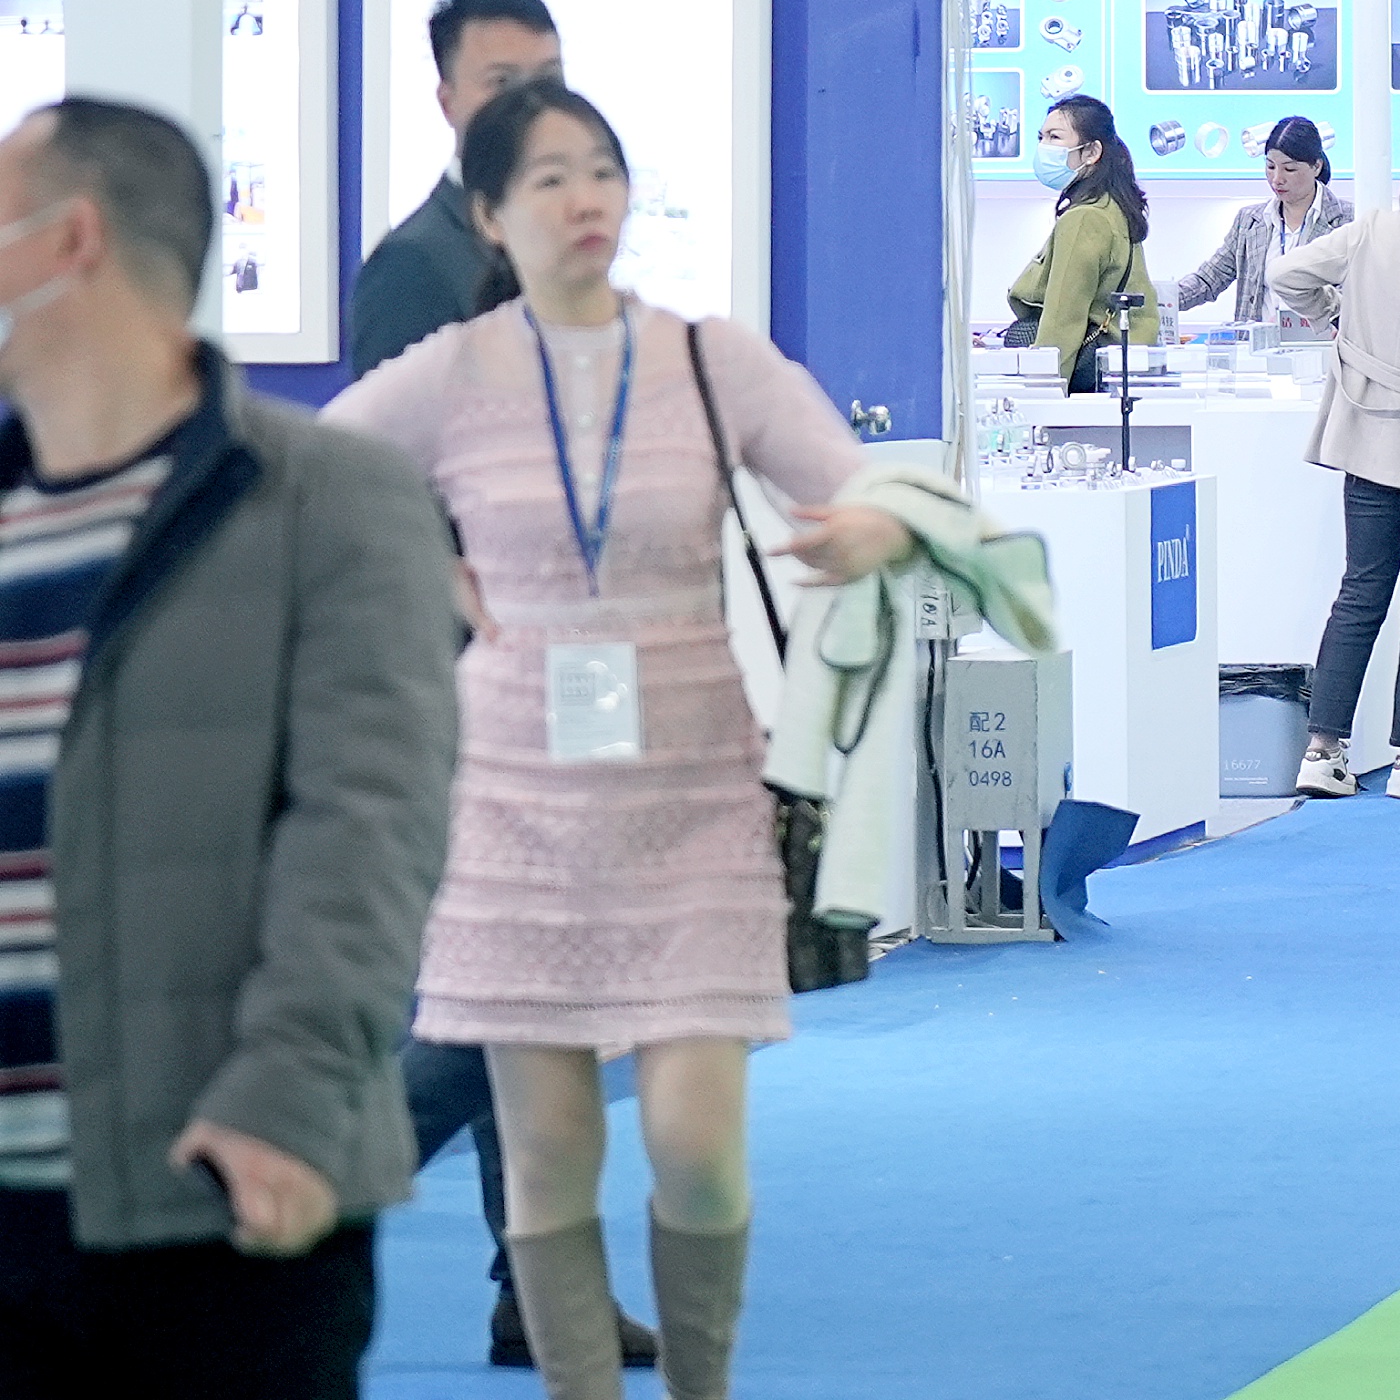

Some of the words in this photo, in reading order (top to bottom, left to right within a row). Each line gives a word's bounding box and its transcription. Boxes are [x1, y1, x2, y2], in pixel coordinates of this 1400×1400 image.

[1156, 536, 1189, 583] PINDA
[968, 739, 1007, 760] 16A
[968, 771, 1013, 788] 0498
